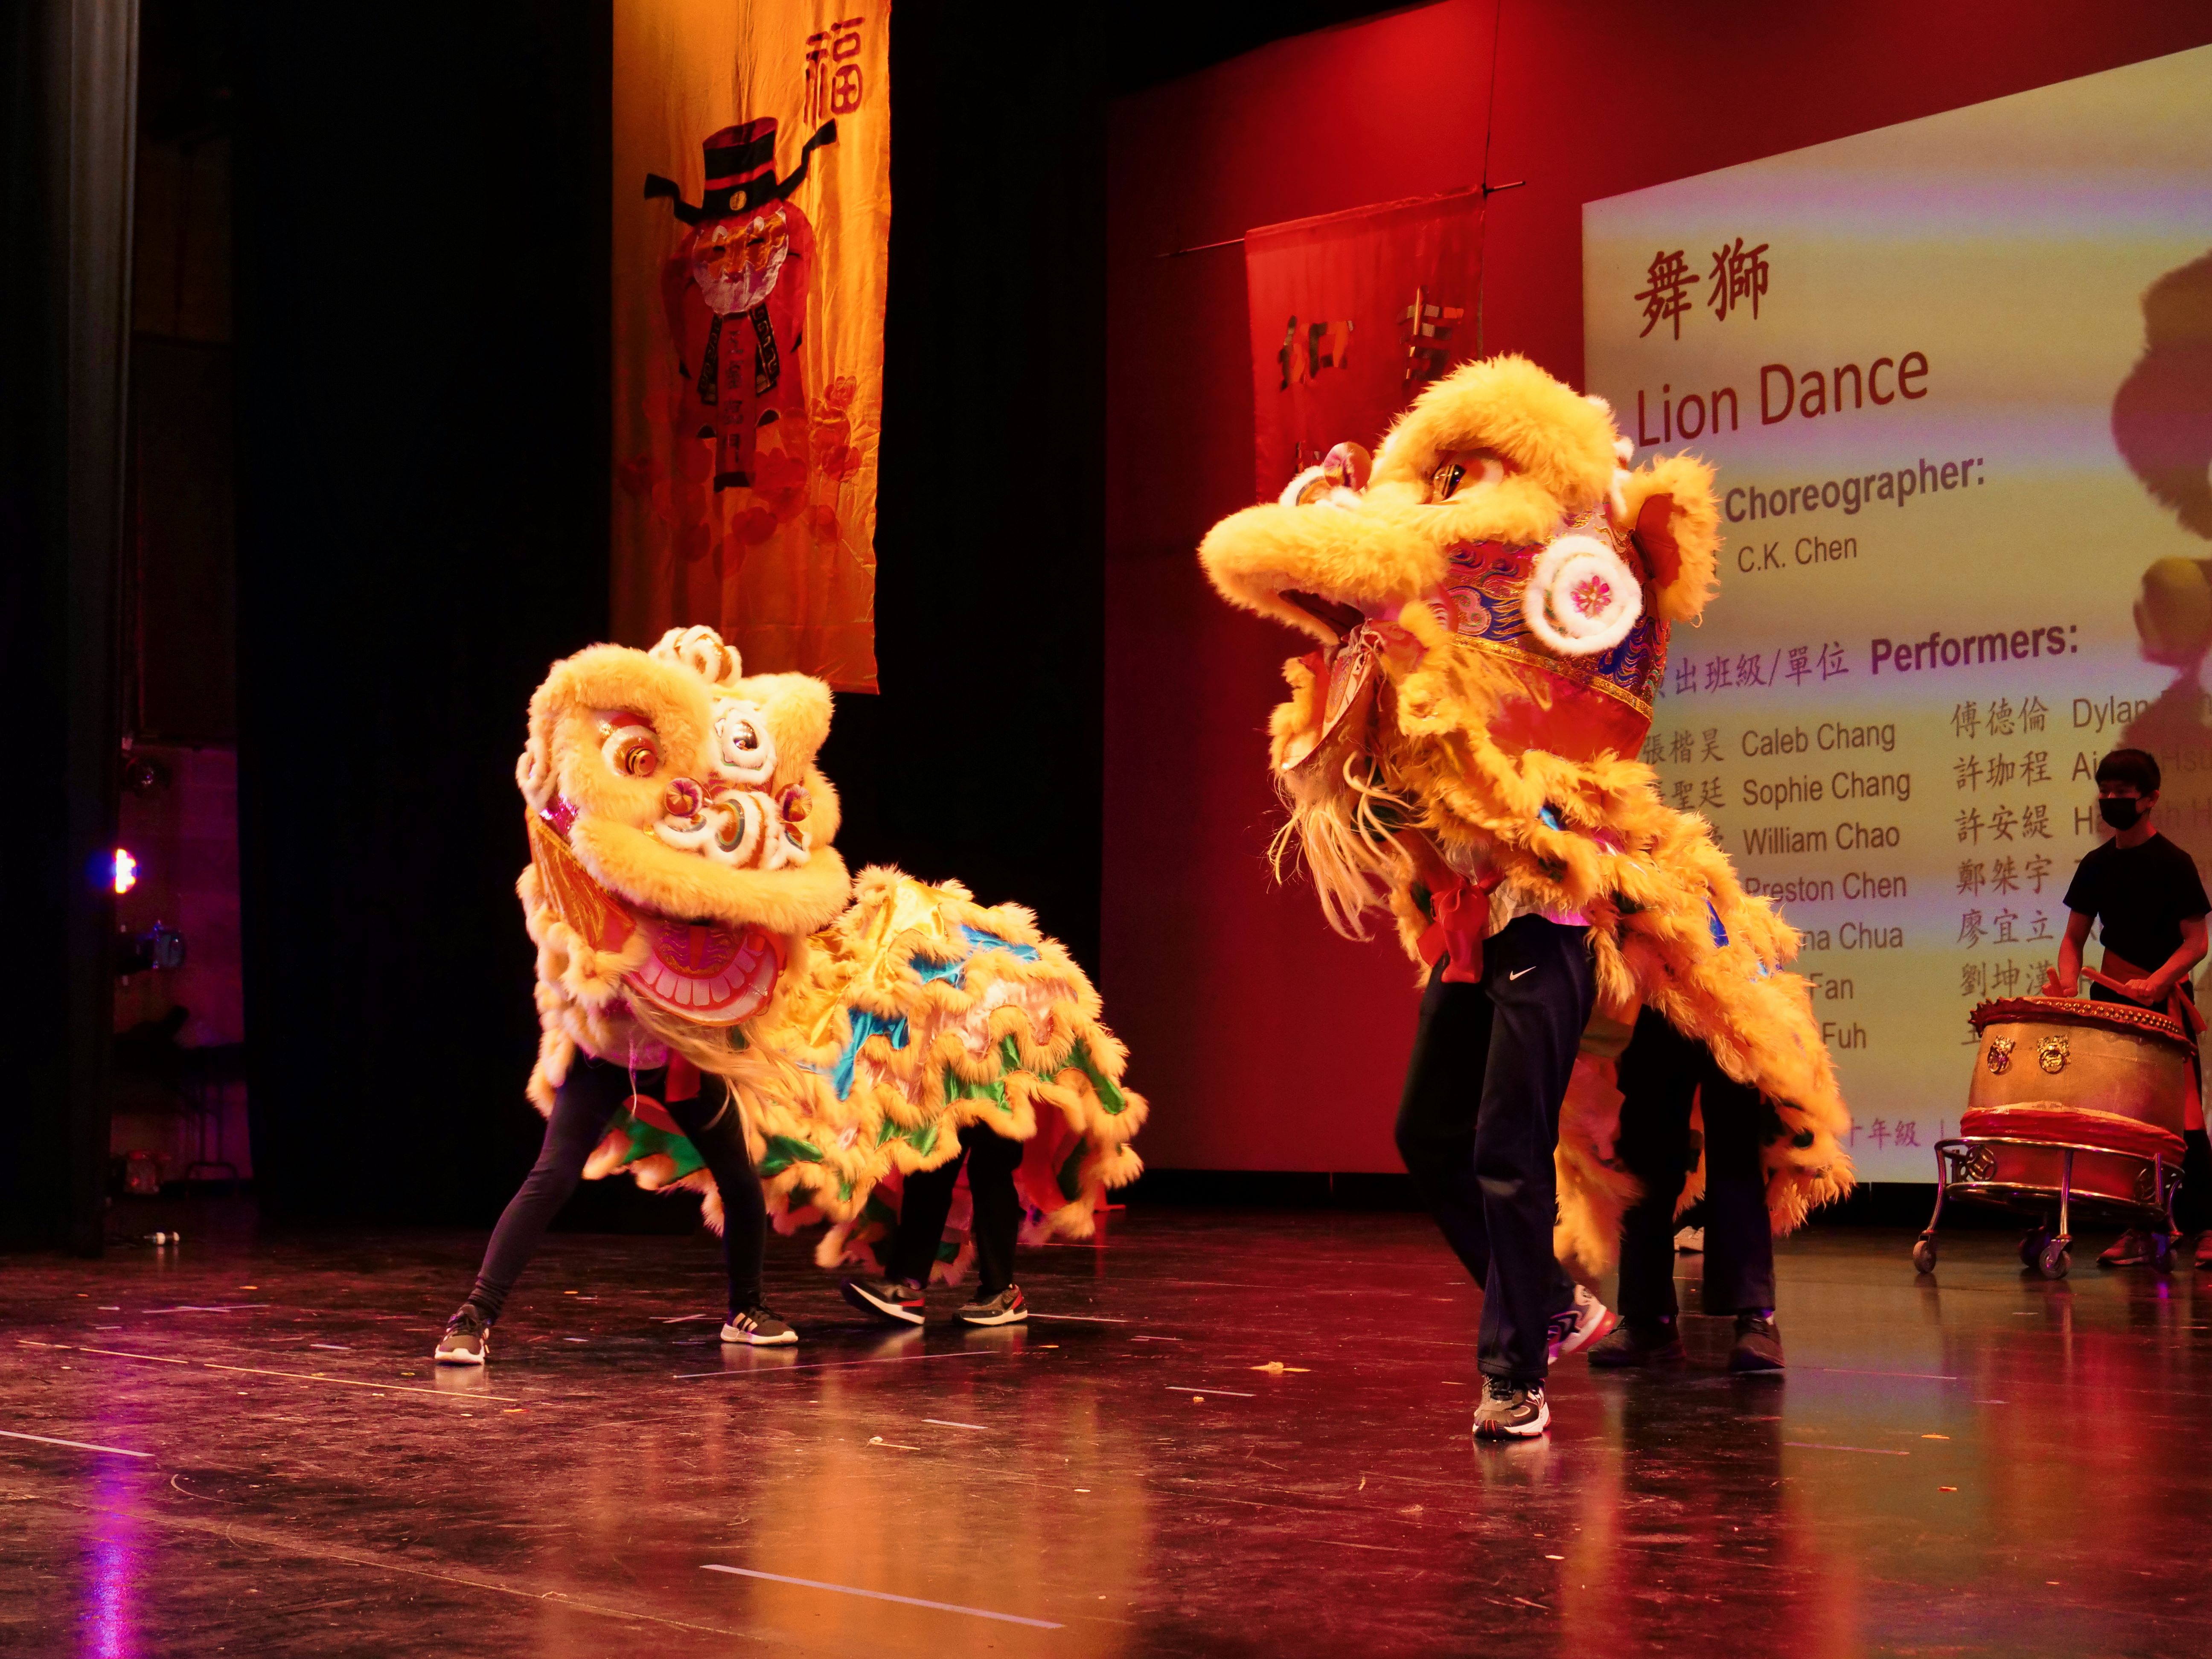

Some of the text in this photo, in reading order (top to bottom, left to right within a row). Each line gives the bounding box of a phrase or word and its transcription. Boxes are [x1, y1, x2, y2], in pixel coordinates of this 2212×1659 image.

[803, 16, 865, 131] 福
[1634, 237, 1769, 341] 舞獅
[1638, 351, 1929, 447] Lion Dance
[1725, 457, 1984, 523] Choreographer:
[1738, 541, 1785, 573] C.K.
[1795, 536, 1857, 565] Chen
[1659, 624, 2078, 698] 出班級/單位 Performers:
[1950, 695, 2049, 739] 傅德倫
[1642, 722, 1895, 764] 張楷昊 Caleb Chang
[1743, 774, 1823, 811] Sophie
[1831, 771, 1910, 802] Chang
[1953, 750, 2052, 792] 許珈程
[1743, 826, 1827, 856] William
[1836, 821, 1900, 850] Chao
[1954, 804, 2054, 846] 許安緹
[1745, 872, 1906, 903] Preston Chen
[1839, 922, 1903, 950] Chua
[1957, 908, 2054, 950] 廖宜立
[1810, 972, 1854, 1000] Fan
[1822, 1022, 1867, 1049] Fuh
